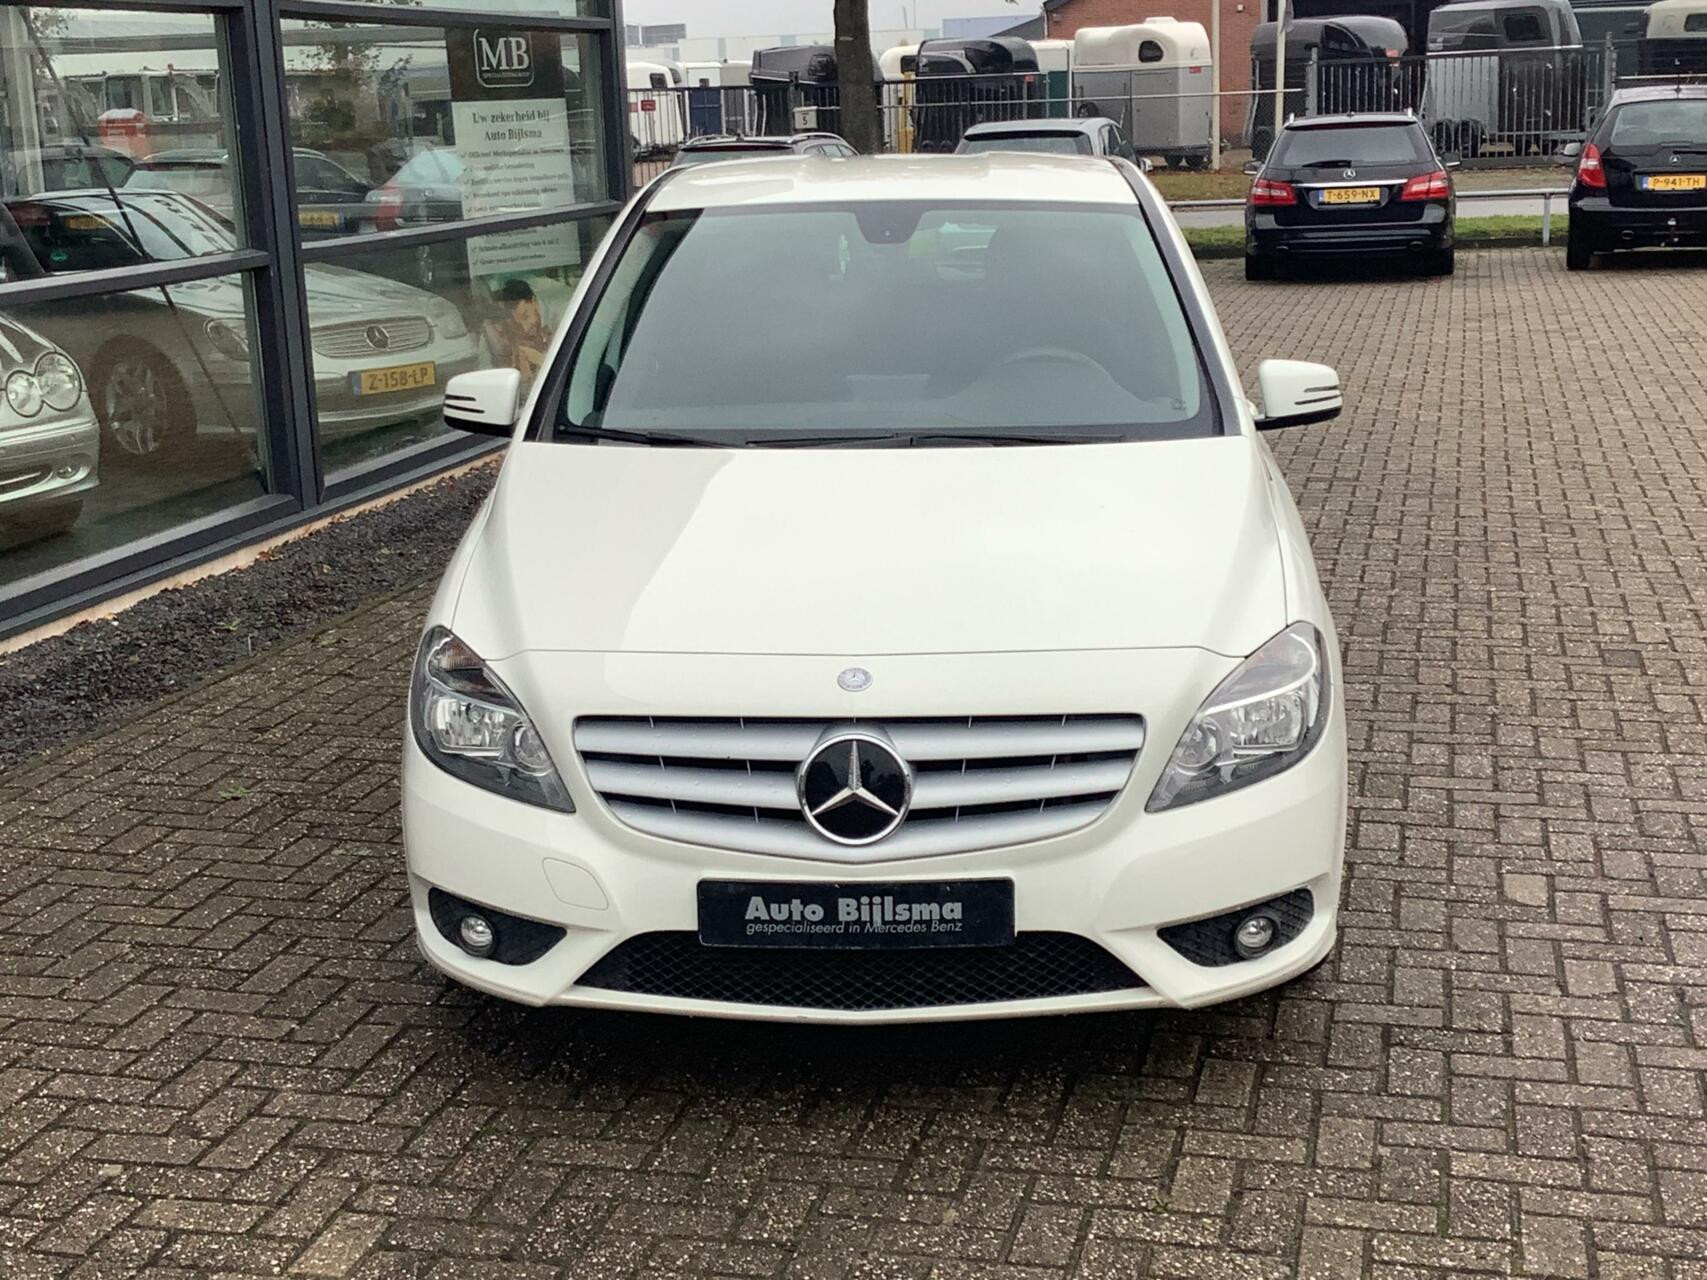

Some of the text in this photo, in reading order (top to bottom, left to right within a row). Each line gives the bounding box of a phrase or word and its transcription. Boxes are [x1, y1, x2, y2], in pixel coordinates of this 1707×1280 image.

[478, 37, 530, 70] MB
[472, 112, 488, 123] Uw
[490, 110, 536, 123] zekerheid
[802, 115, 808, 126] 5
[485, 127, 543, 142] Auto Bijlsma
[1653, 177, 1701, 187] P-941-TH
[1326, 189, 1376, 200] T-659-NX
[368, 367, 428, 391] Z-158-LP
[744, 895, 963, 928] Auto Bijlsma
[746, 919, 963, 936] gespecialiseerd in Mercedes Benz
